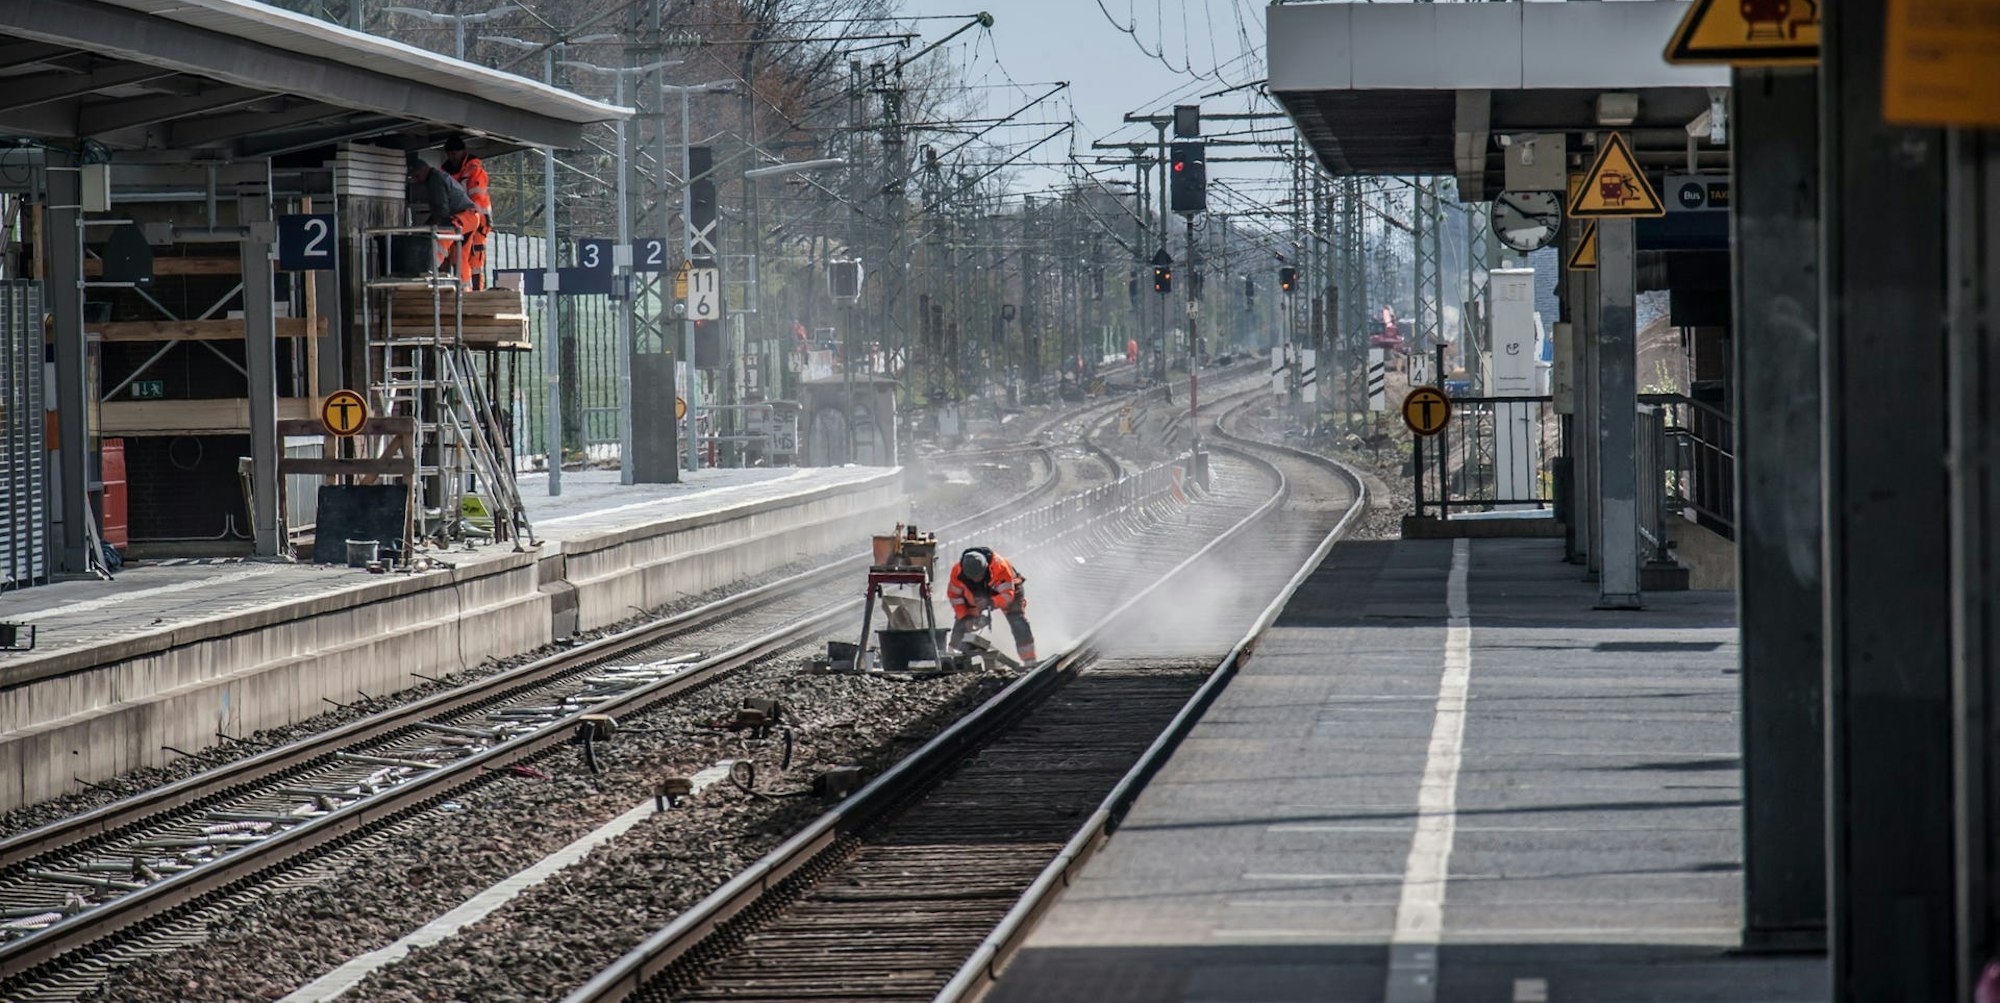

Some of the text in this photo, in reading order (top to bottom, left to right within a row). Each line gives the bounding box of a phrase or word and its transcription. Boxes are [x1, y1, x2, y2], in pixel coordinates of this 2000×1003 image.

[1684, 190, 1701, 200] Bus
[303, 218, 328, 256] 2
[583, 244, 600, 268] 3
[646, 240, 662, 265] 2
[692, 271, 713, 292] 11
[697, 295, 710, 316] 6
[1412, 356, 1425, 368] 11
[1414, 370, 1422, 383] 4
